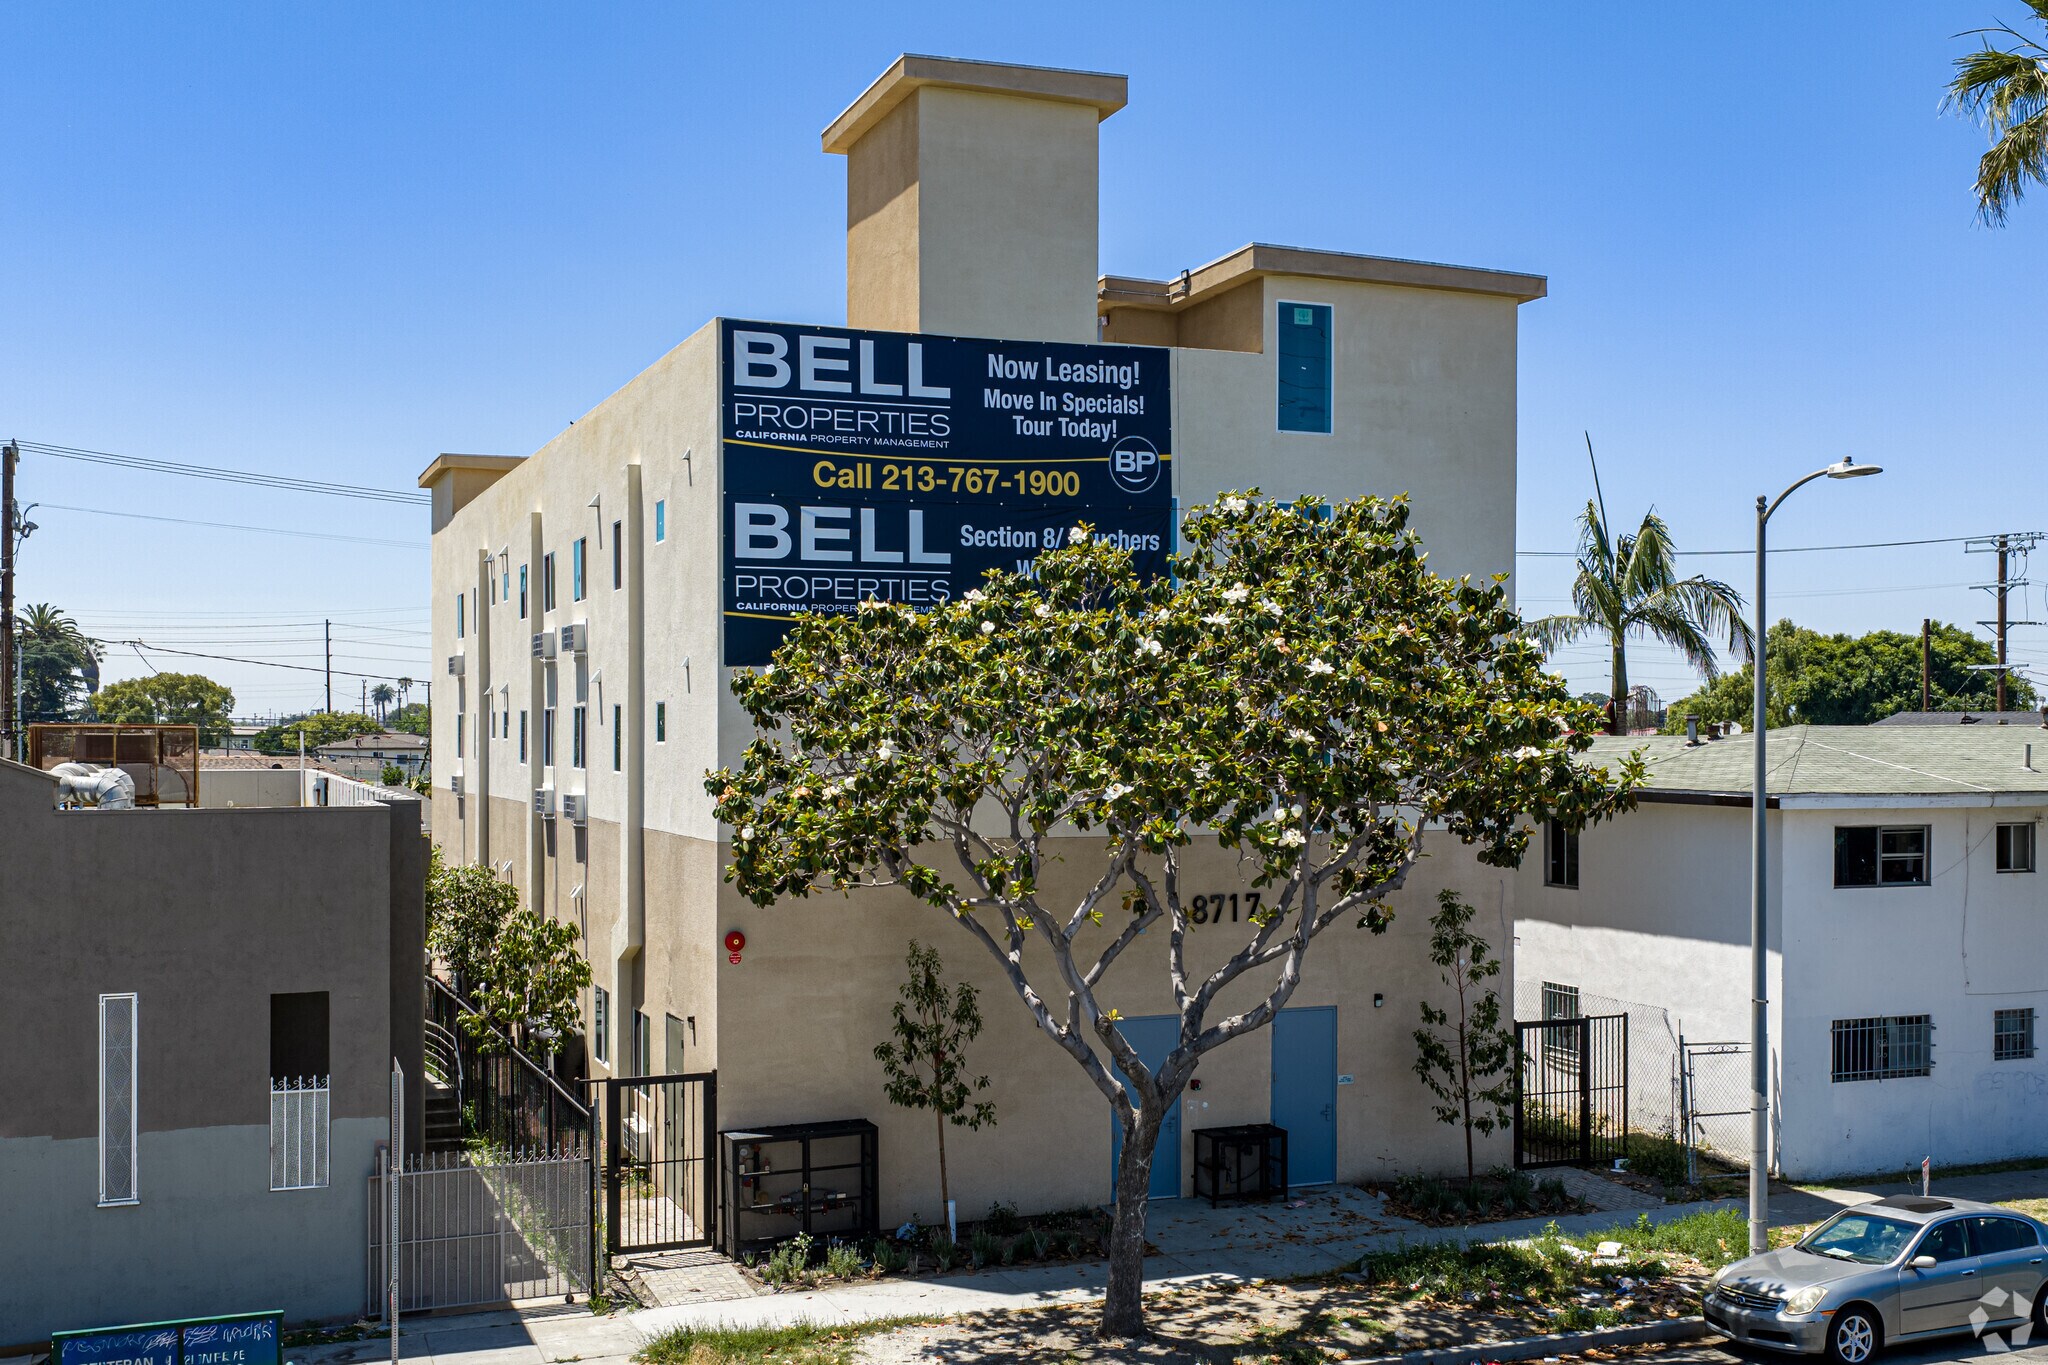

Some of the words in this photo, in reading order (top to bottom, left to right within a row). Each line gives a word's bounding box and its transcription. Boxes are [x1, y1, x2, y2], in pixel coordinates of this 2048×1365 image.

[734, 329, 950, 399] BELL
[988, 353, 1039, 380] Now
[1046, 357, 1140, 390] Leasing!
[984, 388, 1034, 410] Move
[1039, 391, 1057, 411] In
[1062, 392, 1144, 416] Specials!
[734, 402, 950, 436] PROPERTIES
[1012, 415, 1053, 436] Tour
[1058, 417, 1117, 442] Today!
[735, 430, 807, 442] CALIFORNIA
[810, 434, 871, 445] PROPERTY
[874, 437, 950, 449] MANAGEMENT
[1115, 450, 1156, 473] BP
[813, 460, 872, 489] Call
[881, 464, 1080, 496] 213-767-1900
[734, 502, 951, 564] BELL
[960, 524, 1037, 548] Section
[1069, 527, 1160, 551] uchers
[735, 575, 950, 602] PROPERTIES
[736, 602, 808, 613] CALIFORNIA
[811, 603, 863, 614] PROPER
[1192, 892, 1261, 924] 8717
